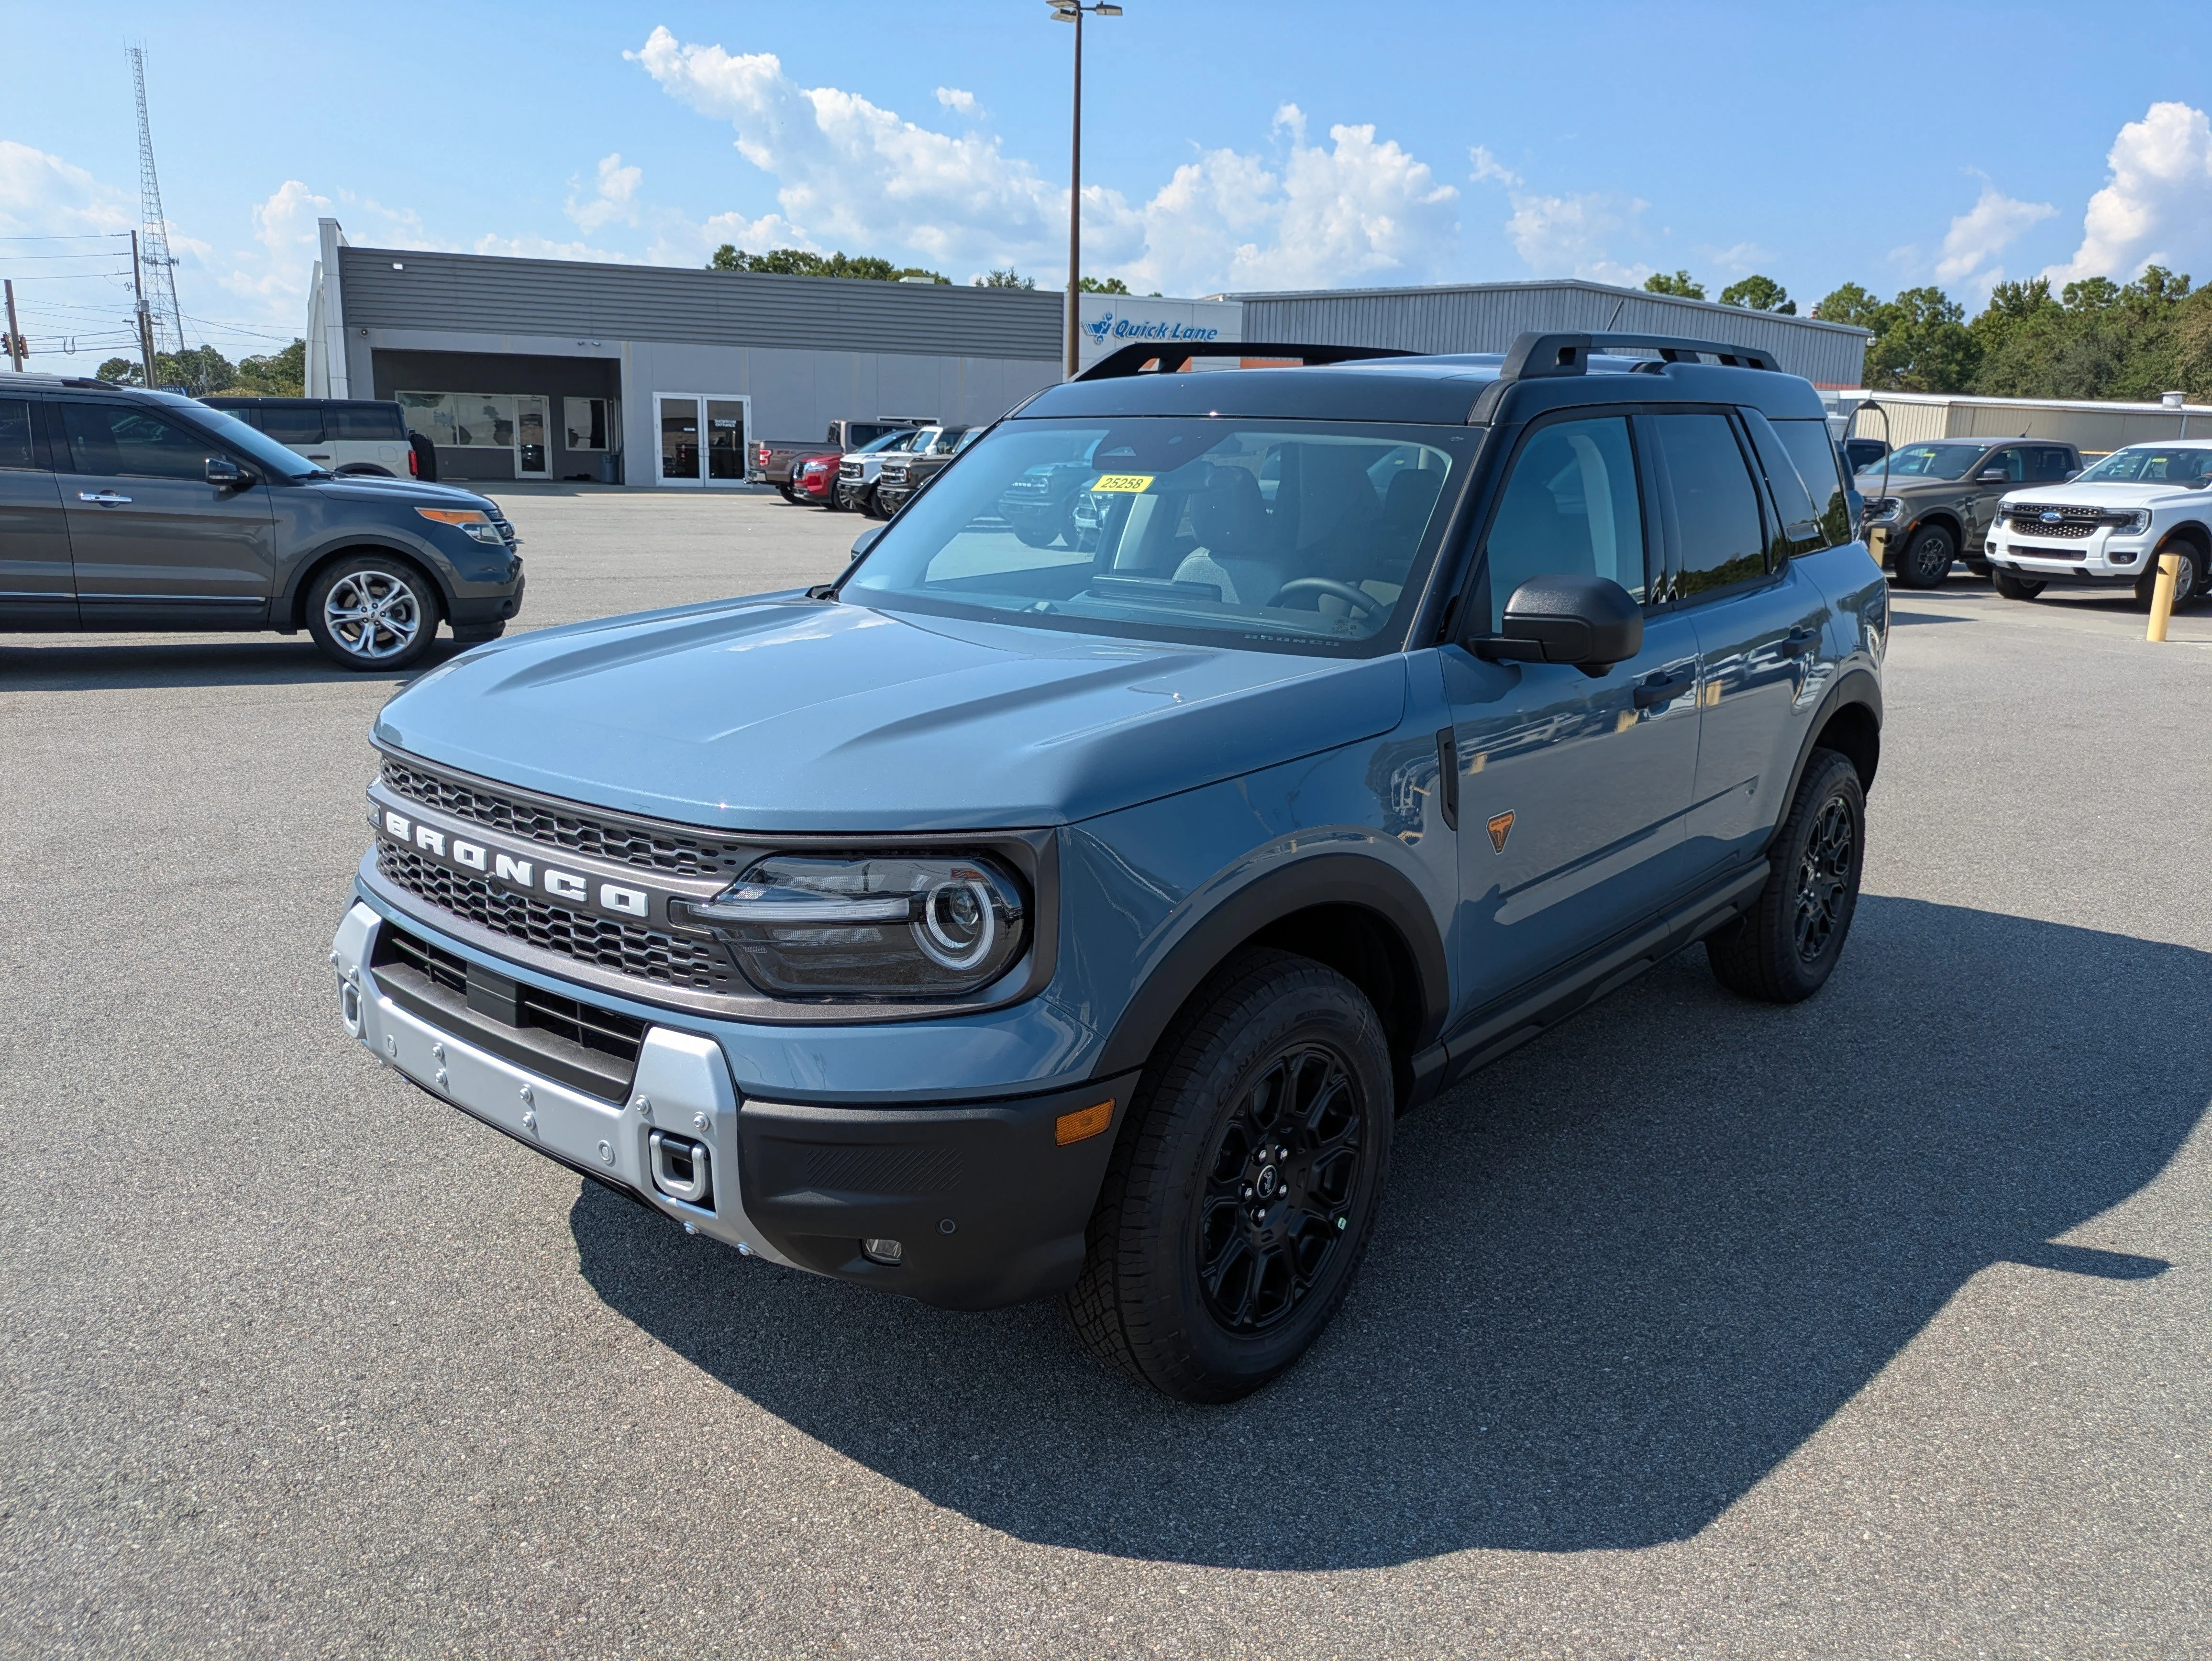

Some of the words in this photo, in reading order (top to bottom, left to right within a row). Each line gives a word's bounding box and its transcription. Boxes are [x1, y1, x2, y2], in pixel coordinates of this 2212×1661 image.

[1114, 320, 1170, 339] Quick
[1170, 323, 1218, 341] Lane
[1100, 477, 1144, 489] 25258
[1244, 634, 1339, 646] BRONCO
[386, 811, 649, 917] BRONCO
